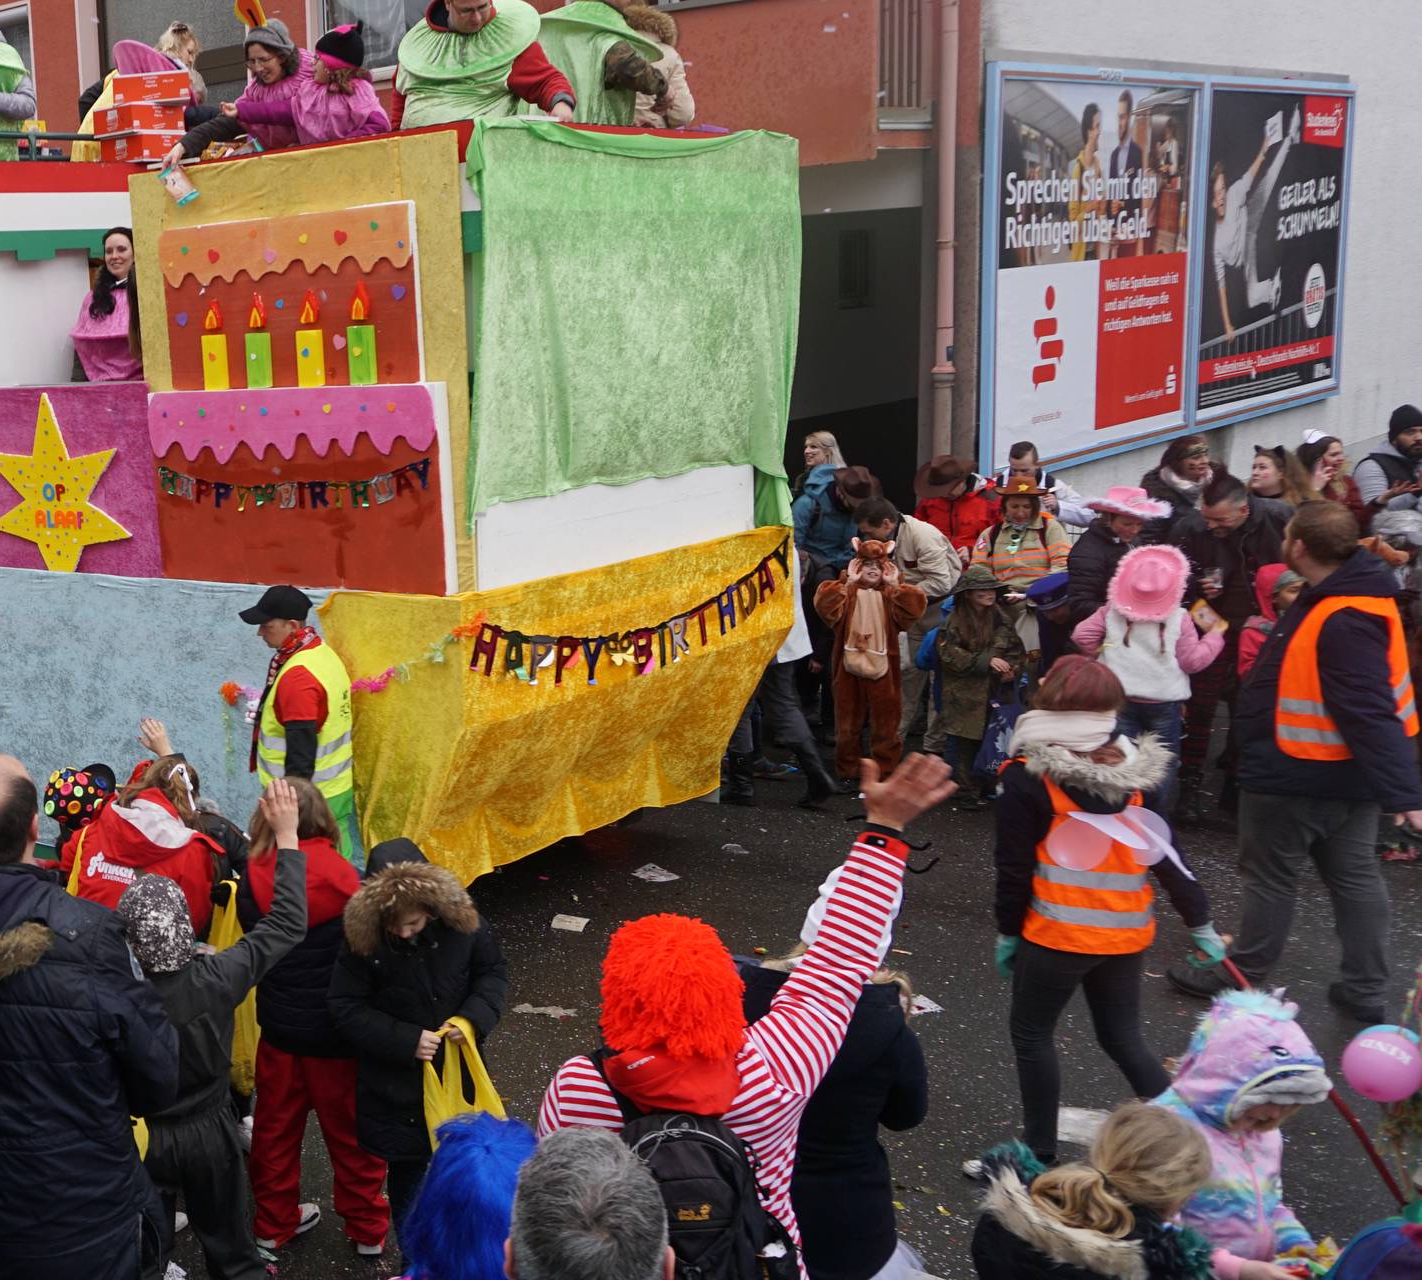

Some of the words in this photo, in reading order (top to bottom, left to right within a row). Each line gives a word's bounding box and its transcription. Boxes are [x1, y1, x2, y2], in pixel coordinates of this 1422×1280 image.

[1005, 171, 1078, 213] Sprechen
[1082, 170, 1103, 200] Sie
[1106, 169, 1131, 200] mit
[1133, 169, 1157, 199] den
[1279, 178, 1316, 211] GEILER
[1318, 176, 1336, 201] ALS
[1005, 213, 1078, 253] Richtigen
[1082, 211, 1114, 242] über
[1116, 209, 1151, 240] Geld.
[1276, 200, 1340, 241] SCHUMMELN!
[42, 483, 66, 502] OP
[158, 466, 252, 512] HAPPY
[278, 457, 431, 509] BIRTHDAY
[34, 509, 83, 530] ALAAF
[469, 621, 607, 688] HAPPY
[630, 534, 791, 676] BIRTHDAY
